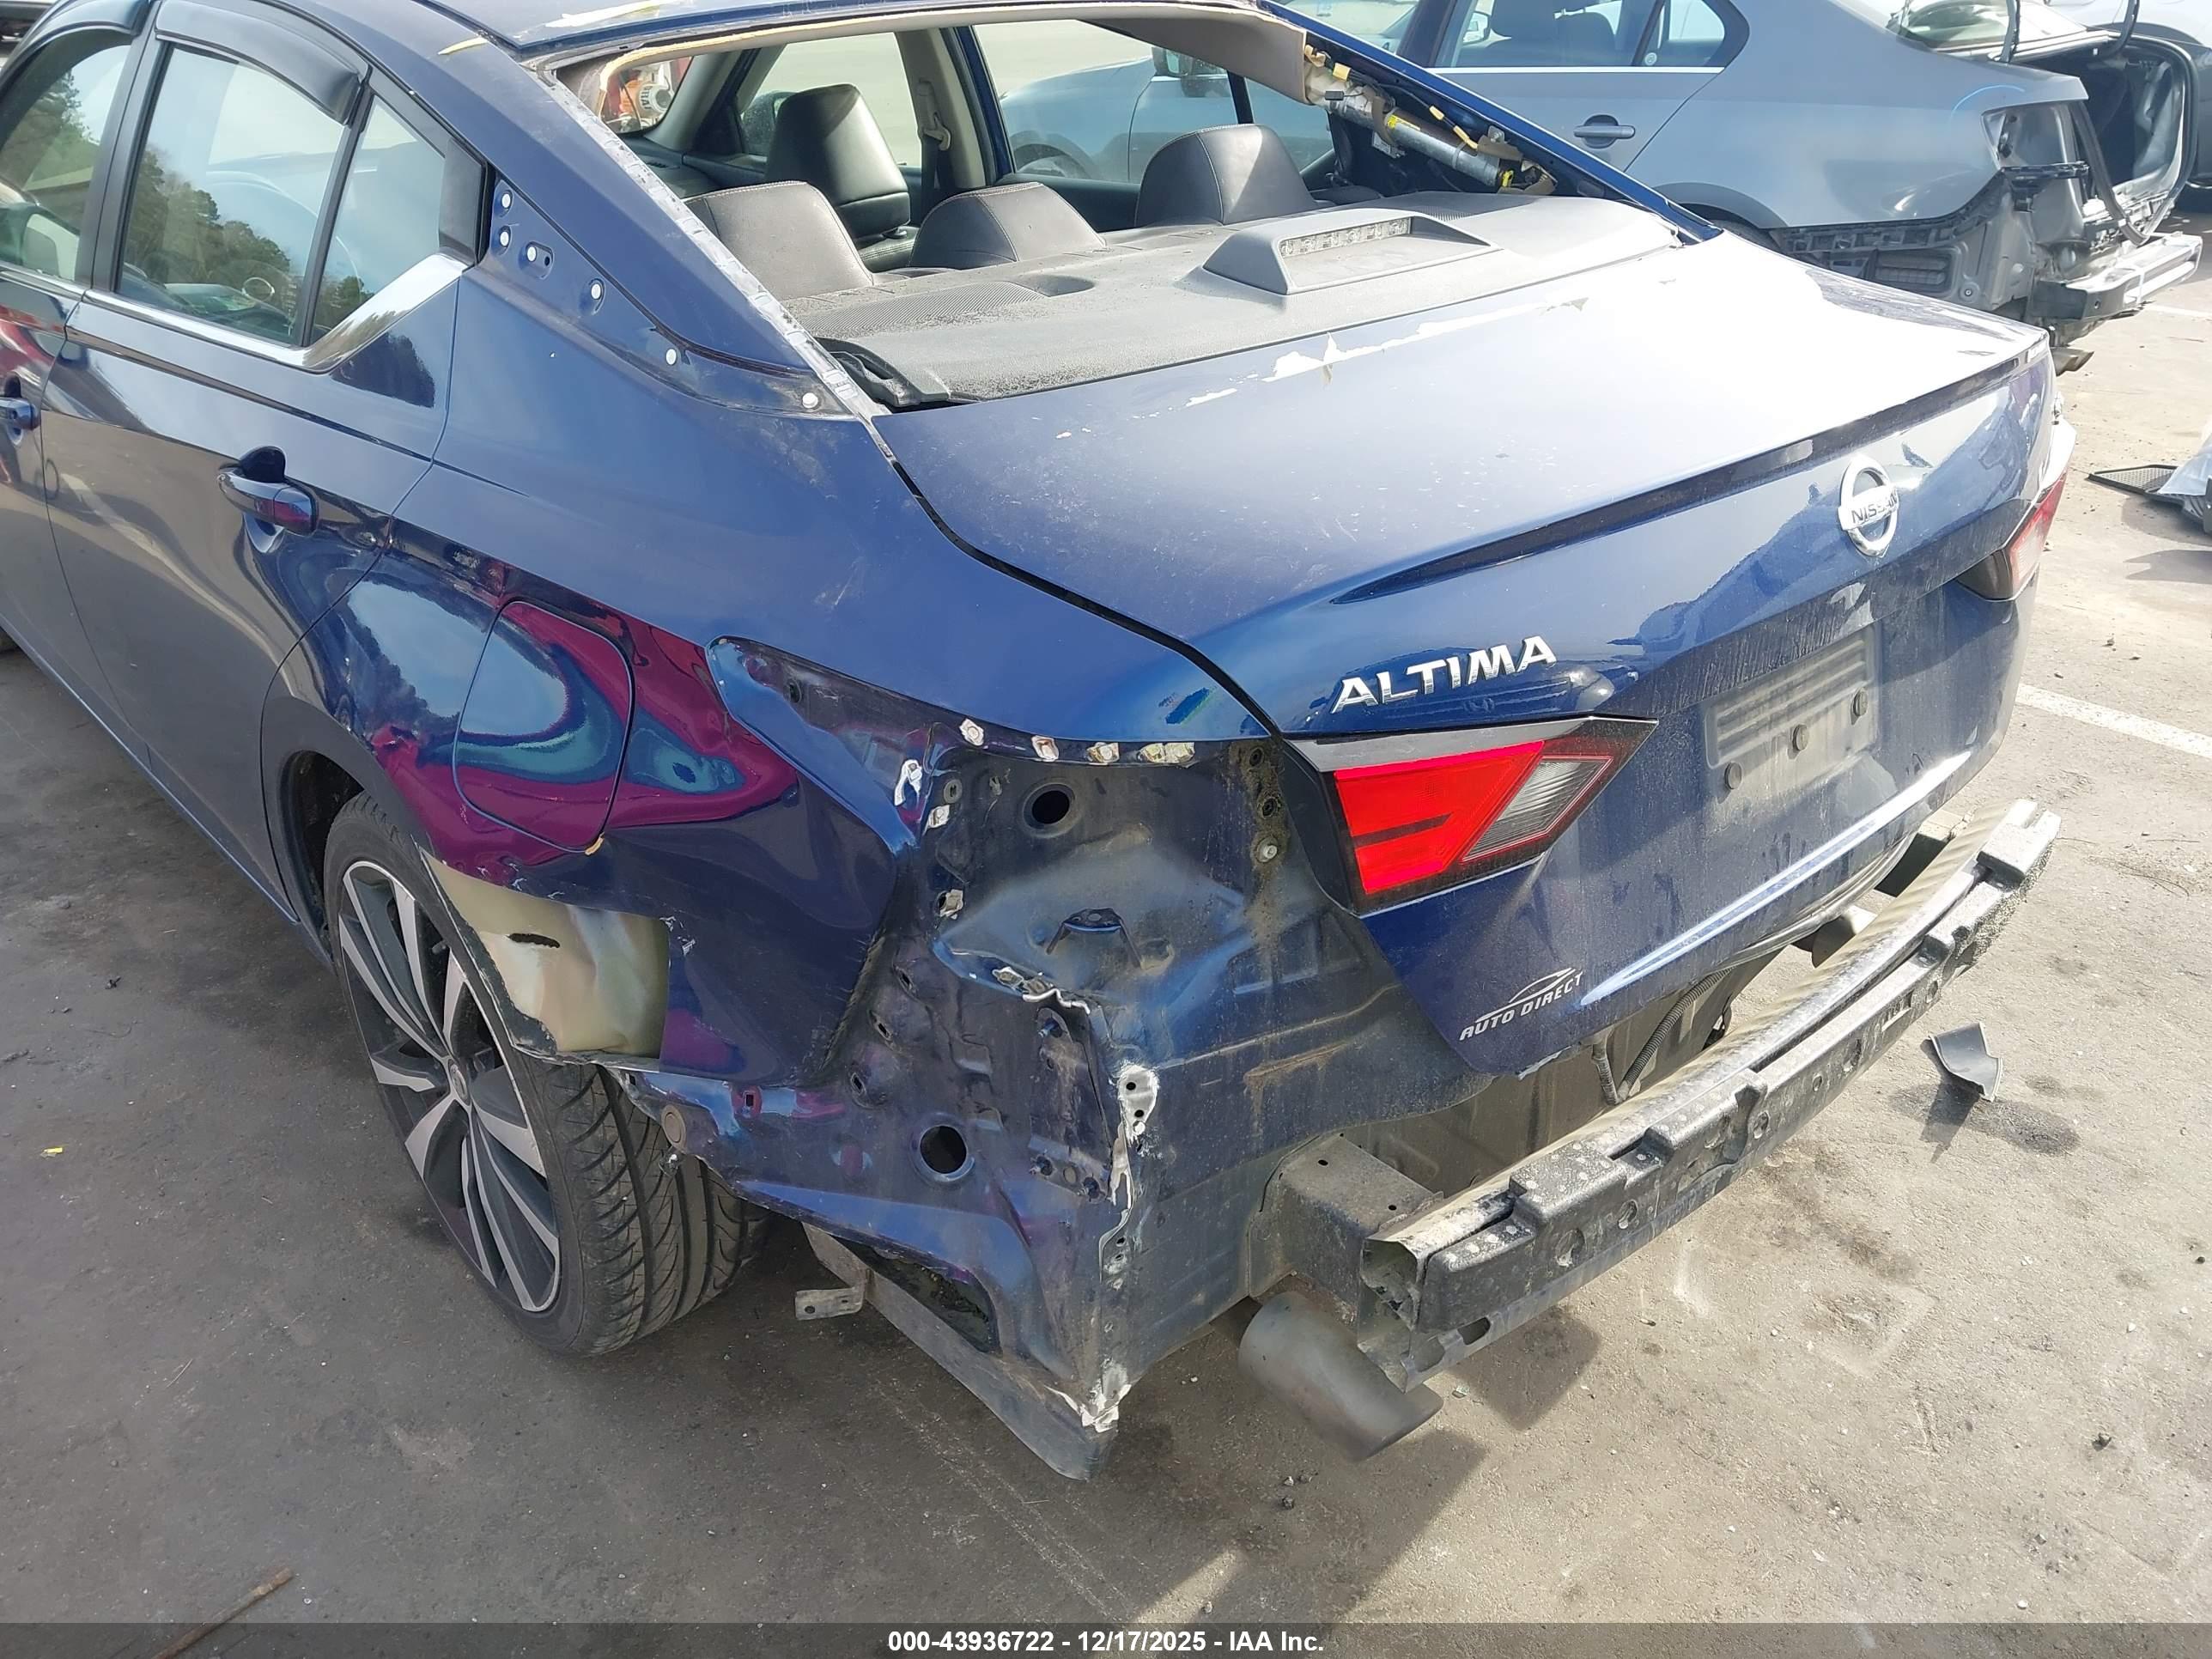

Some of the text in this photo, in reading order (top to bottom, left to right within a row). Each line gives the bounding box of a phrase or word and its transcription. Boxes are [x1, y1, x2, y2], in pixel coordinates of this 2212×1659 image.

[1330, 635, 1558, 714] ALTIMA
[1459, 971, 1583, 1041] AUTO DIRECT
